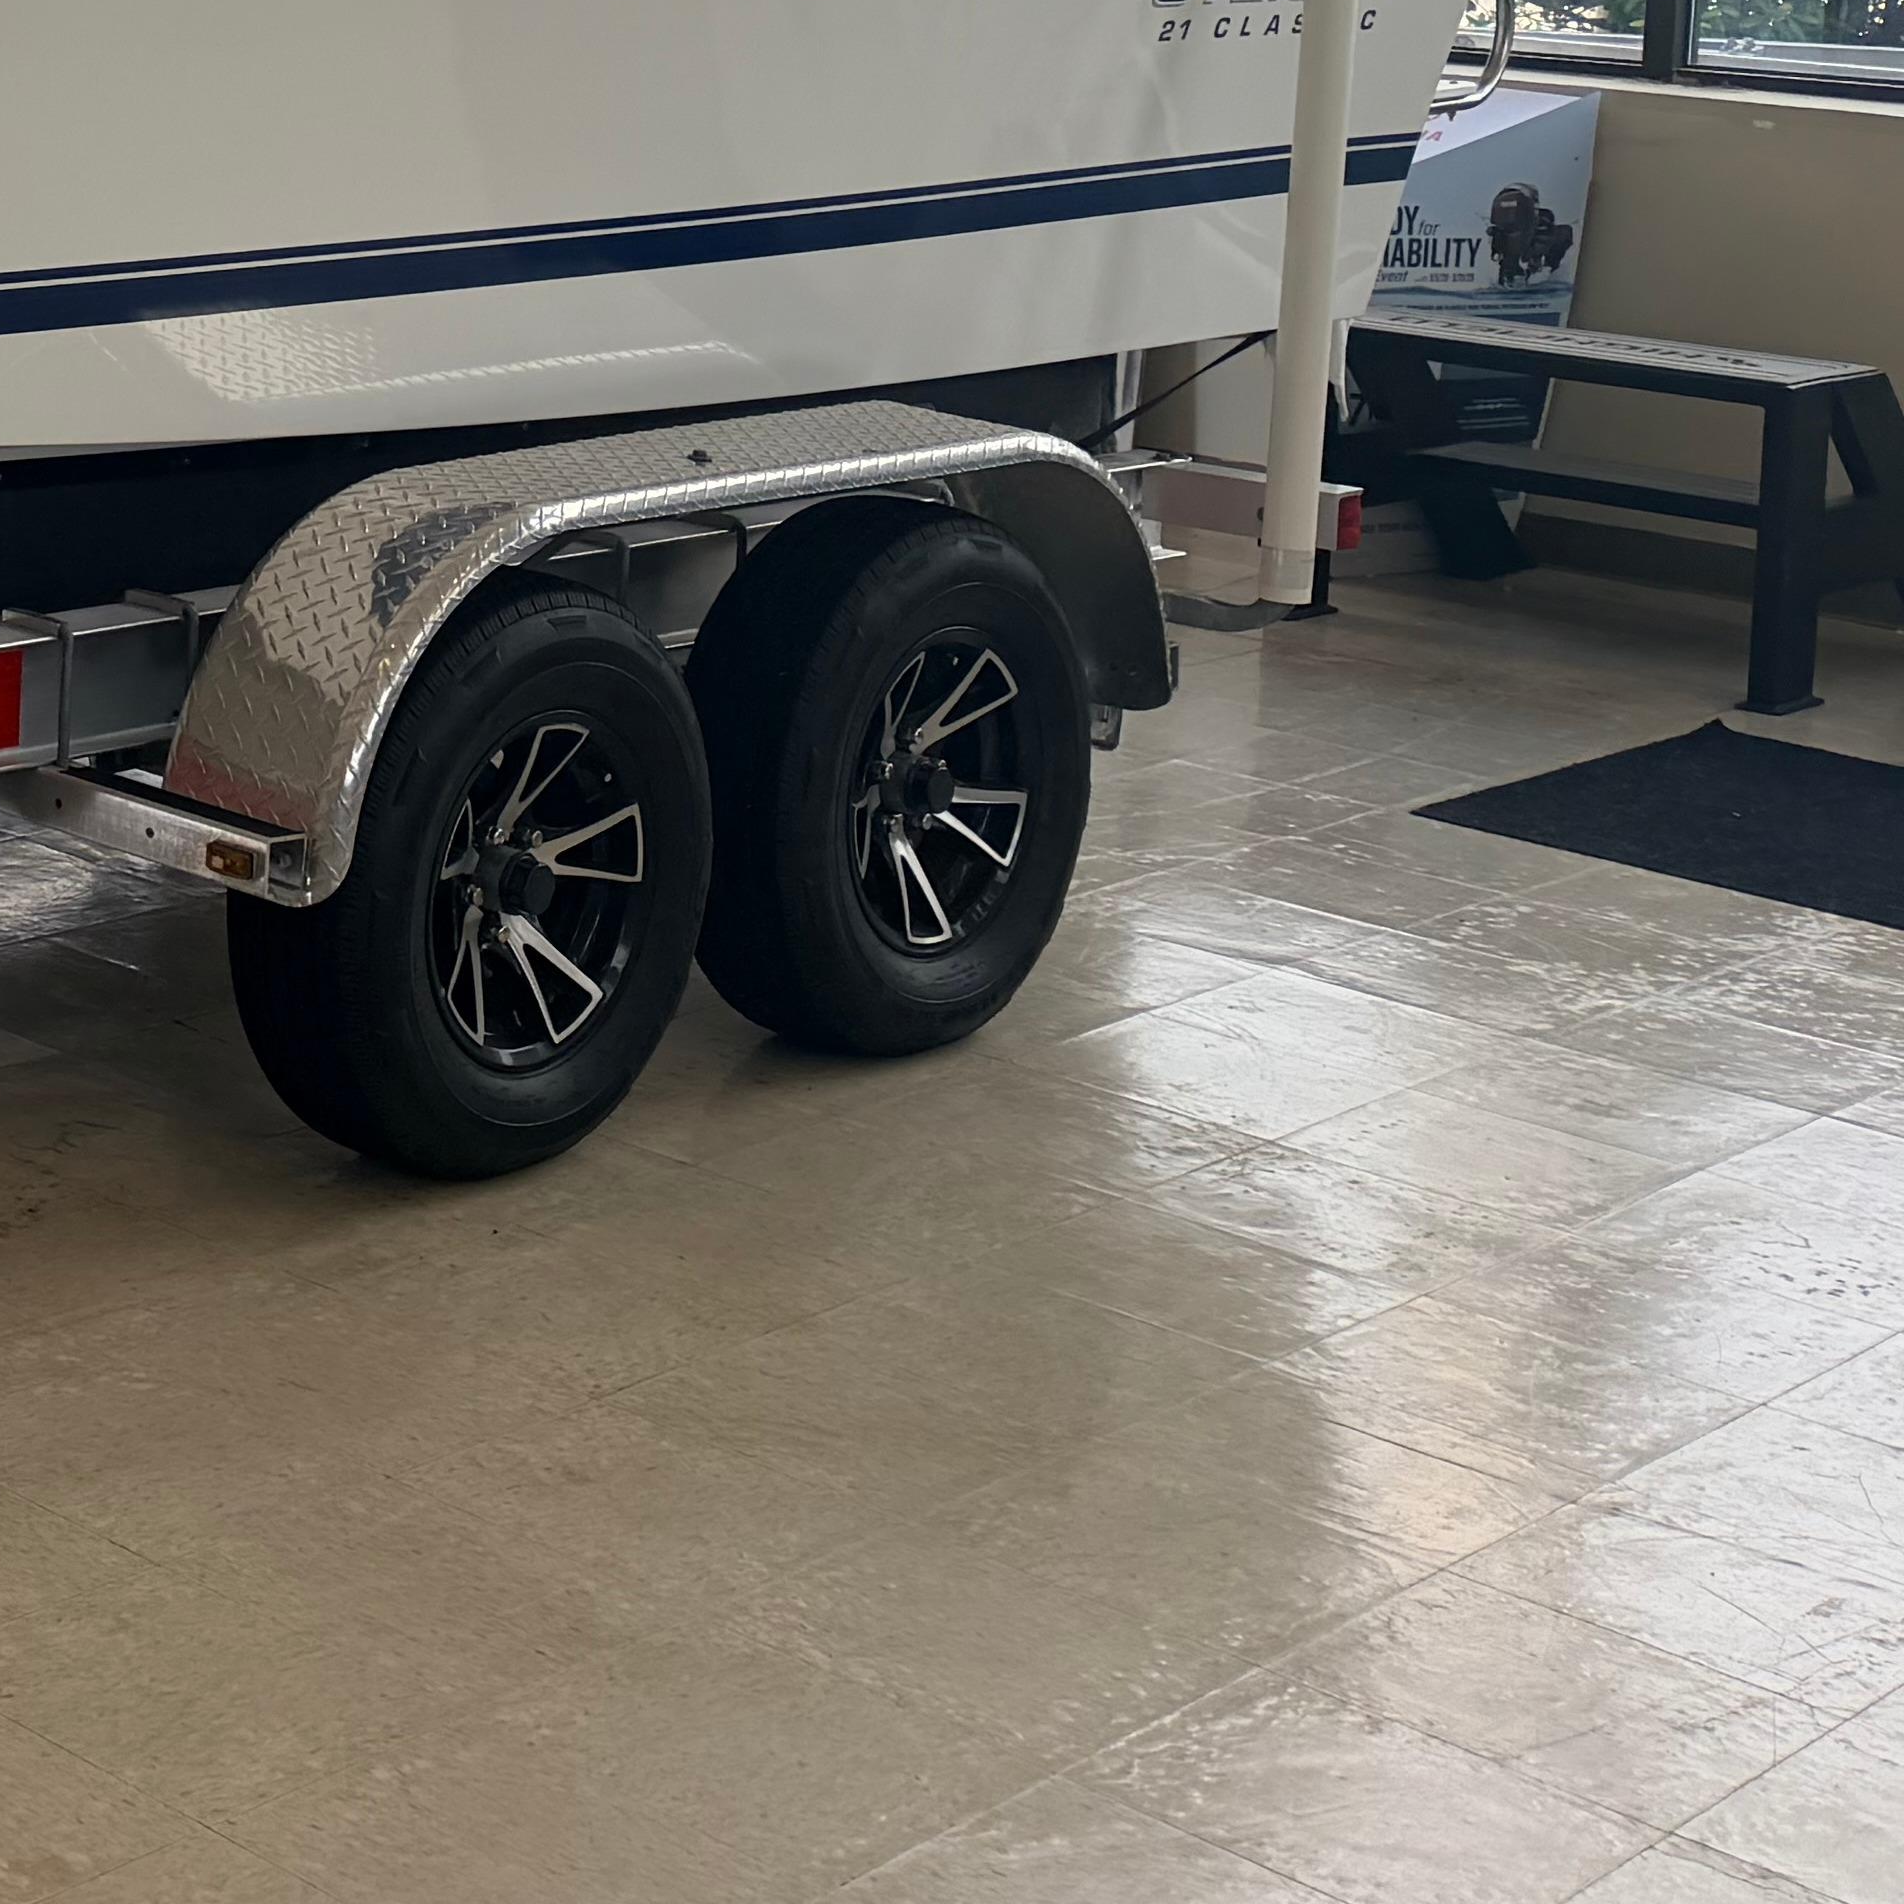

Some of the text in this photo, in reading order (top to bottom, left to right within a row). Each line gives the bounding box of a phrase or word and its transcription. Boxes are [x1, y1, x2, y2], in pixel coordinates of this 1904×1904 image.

[1158, 9, 1377, 42] 21 CLASC
[1417, 219, 1441, 236] for
[1382, 237, 1483, 268] IABILITY
